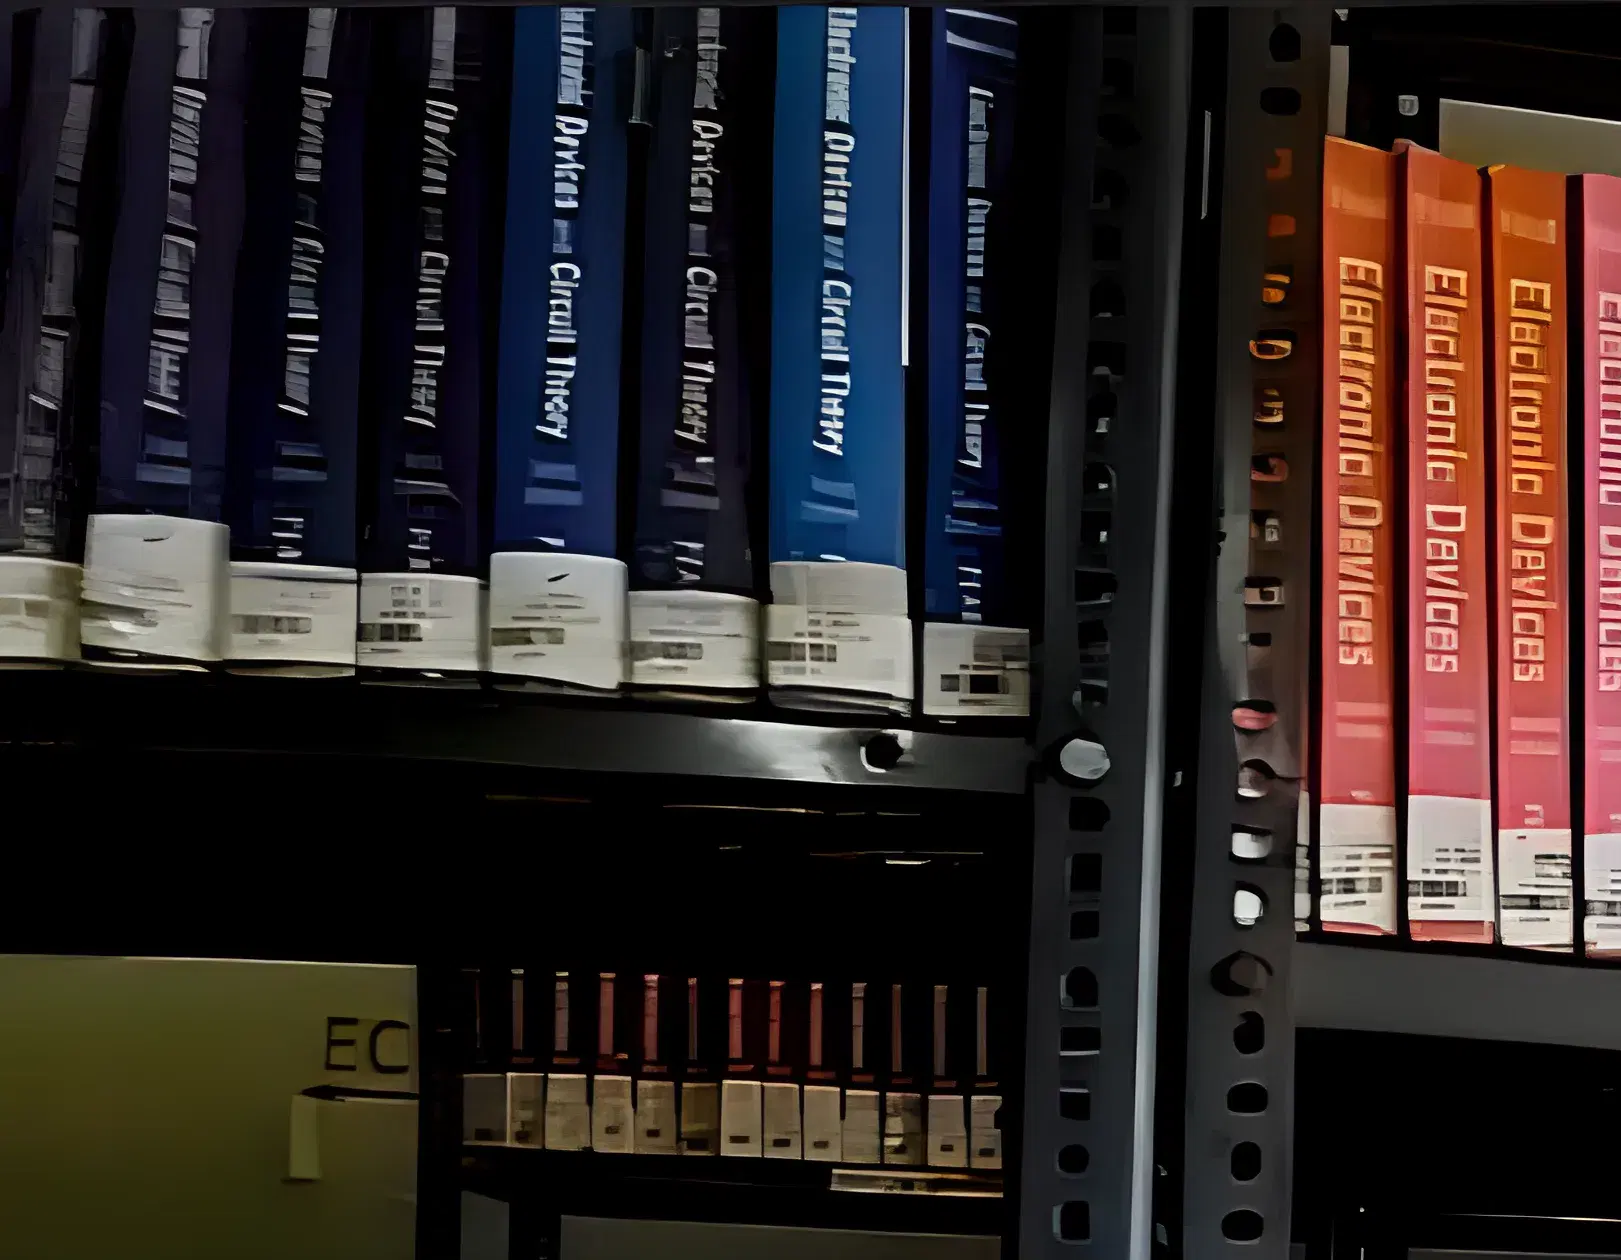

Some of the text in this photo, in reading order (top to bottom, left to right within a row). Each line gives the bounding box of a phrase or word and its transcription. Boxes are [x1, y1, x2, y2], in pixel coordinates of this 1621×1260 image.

[1338, 495, 1384, 666] Devices
[1425, 265, 1468, 673] Electronic Devices
[1510, 278, 1557, 683] Electronic Devices
[325, 1016, 410, 1074] EC
